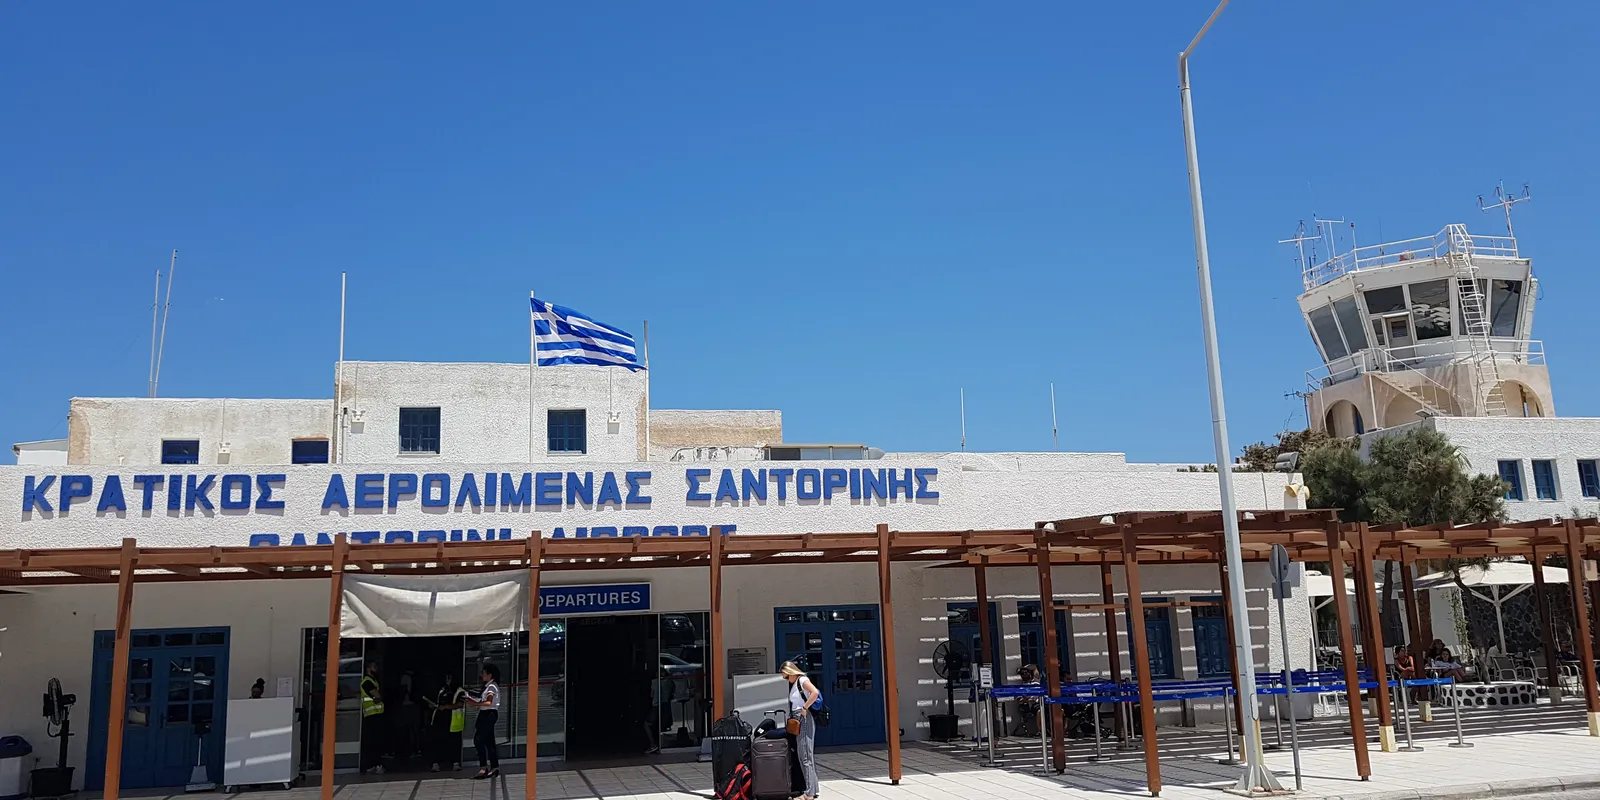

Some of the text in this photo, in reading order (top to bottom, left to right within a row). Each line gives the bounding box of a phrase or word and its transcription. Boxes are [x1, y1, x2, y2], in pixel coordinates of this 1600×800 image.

[22, 468, 940, 512] ΚΡΑΤΙΚΟΣ ΑΕΡΟΛΙΜΕΝΑΣ ΣΑΝΤΟΡΙΝΗΣ
